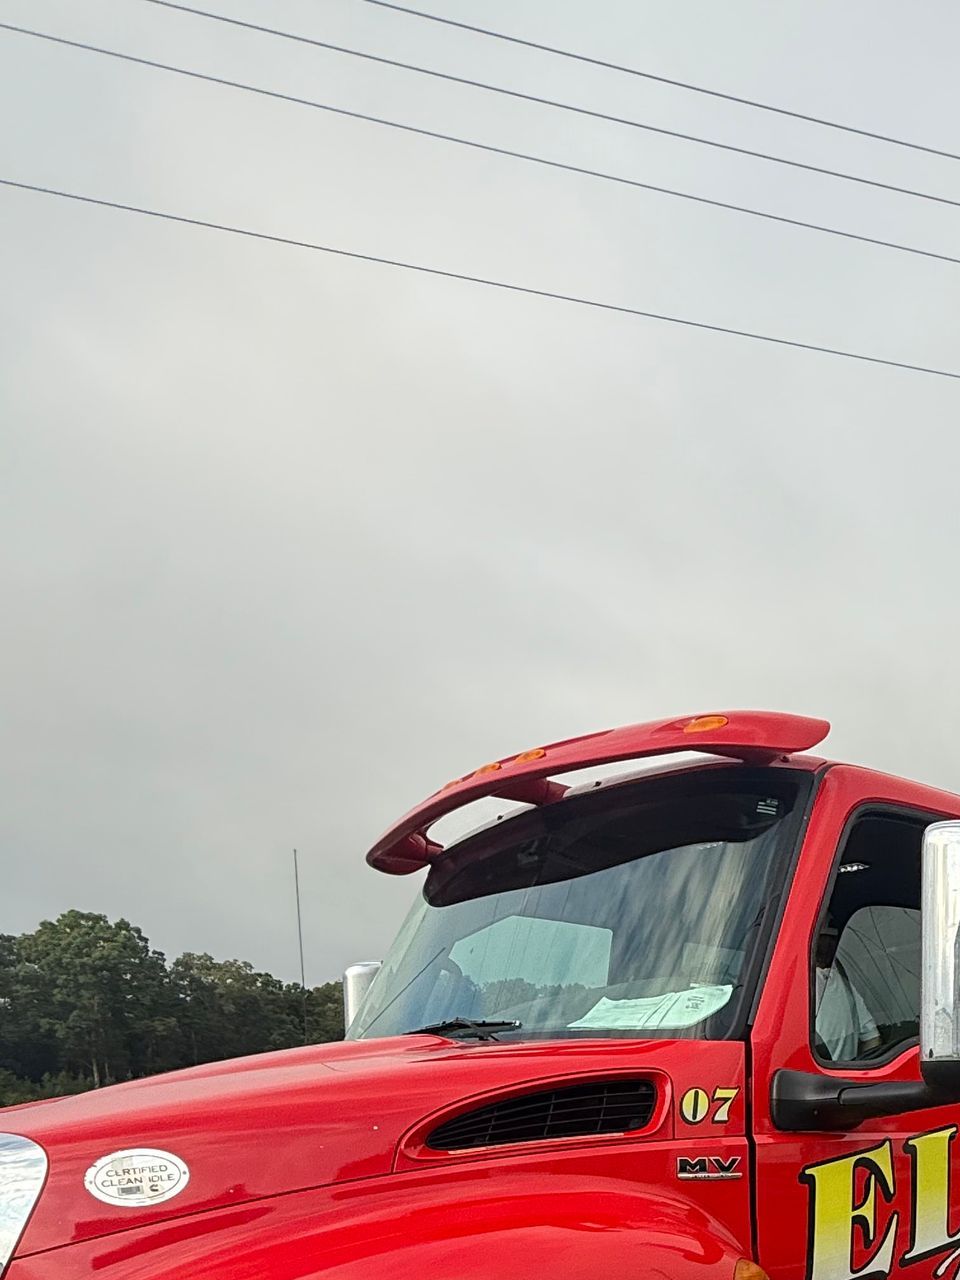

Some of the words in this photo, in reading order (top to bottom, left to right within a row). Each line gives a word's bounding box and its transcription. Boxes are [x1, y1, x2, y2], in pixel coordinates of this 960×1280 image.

[681, 1087, 740, 1125] 07
[106, 1164, 168, 1178] CERTIFIED
[677, 1156, 741, 1173] MV
[101, 1176, 143, 1188] CLEAN
[148, 1173, 175, 1183] IDLE
